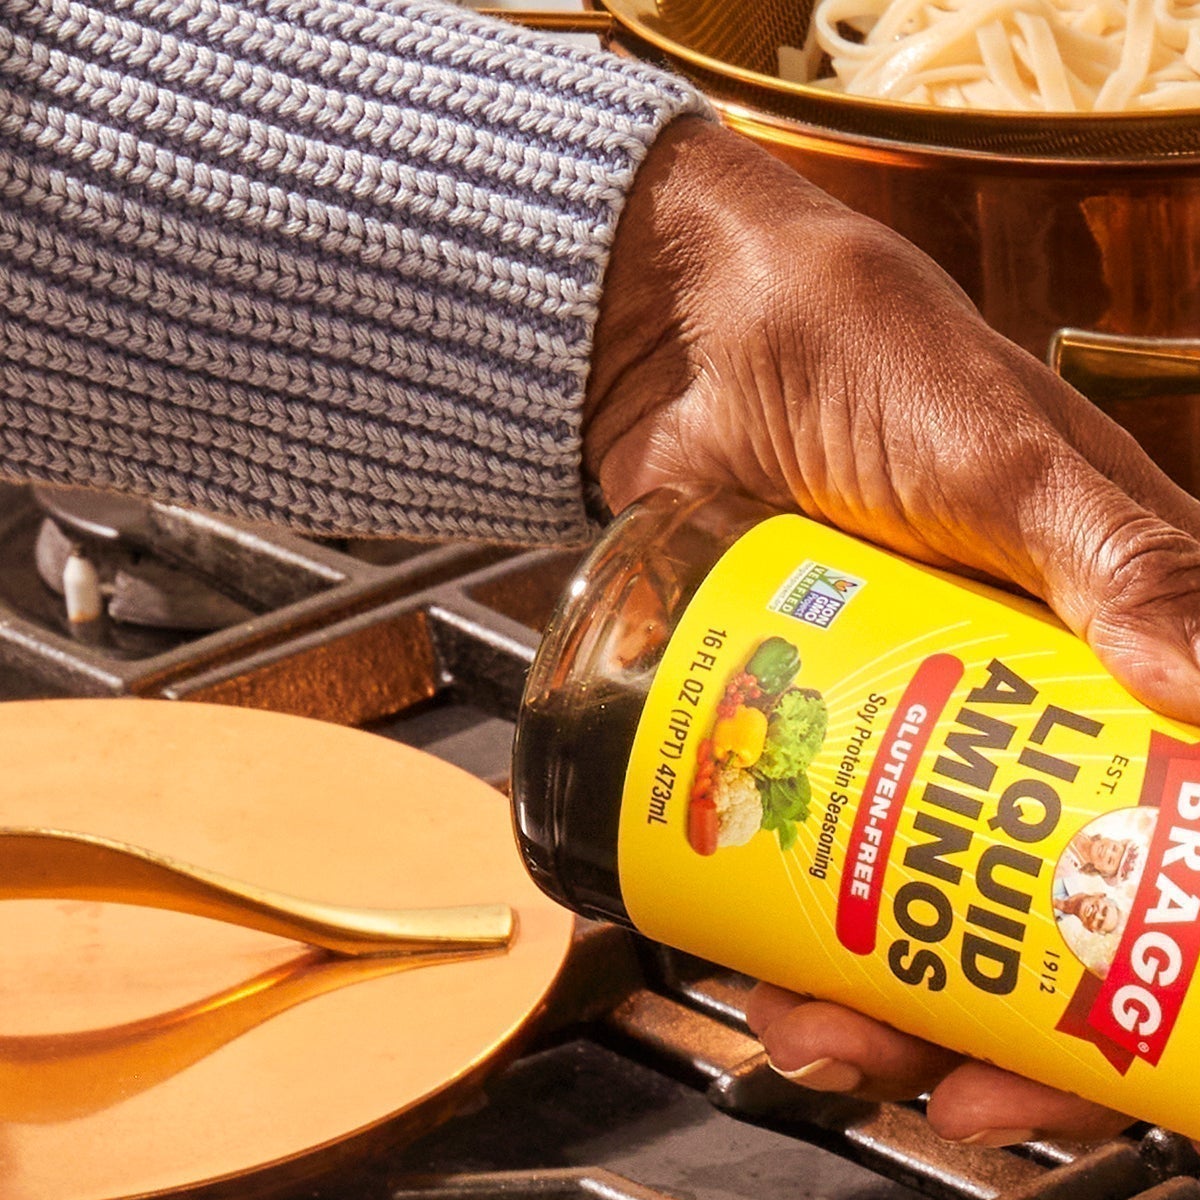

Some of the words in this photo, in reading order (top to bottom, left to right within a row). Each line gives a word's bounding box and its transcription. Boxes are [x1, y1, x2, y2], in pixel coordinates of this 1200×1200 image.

[782, 566, 826, 613] VERIFIED
[804, 596, 829, 621] GMO
[815, 599, 841, 626] NON
[689, 649, 716, 672] FL
[702, 628, 728, 650] 16
[678, 679, 704, 707] OZ
[856, 692, 888, 724] Soy
[663, 708, 693, 761] (1PT)
[834, 726, 872, 788] Protein
[647, 763, 677, 825] 473mL
[1096, 754, 1129, 795] EST.
[849, 702, 928, 900] GLUTEN-FREE
[809, 791, 848, 880] Seasoning
[888, 657, 1040, 992] AMINOS
[960, 704, 1105, 996] LIQUID
[1040, 951, 1062, 995] 1912
